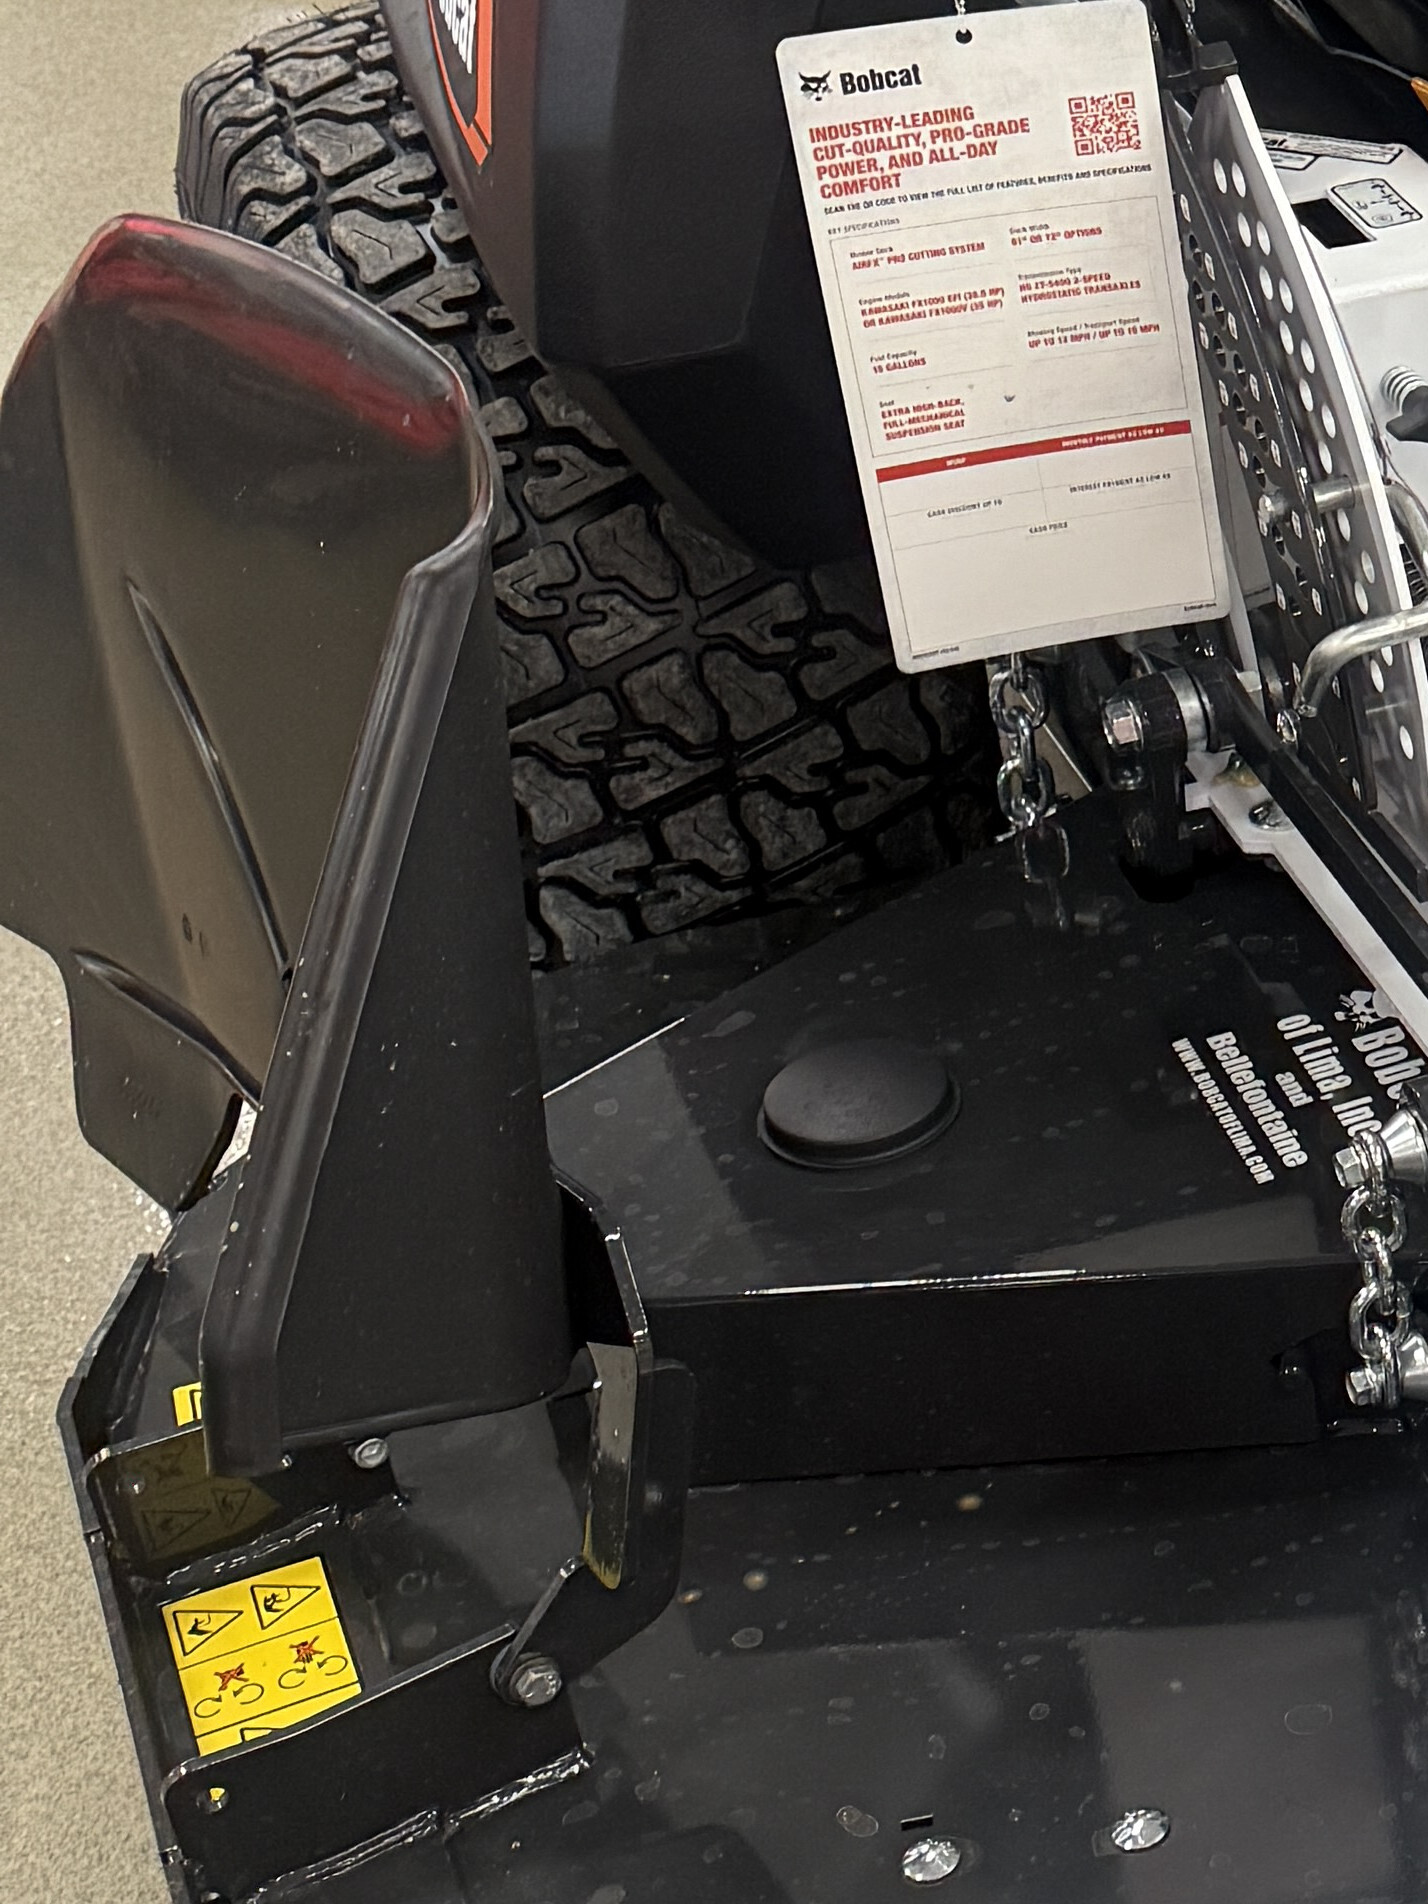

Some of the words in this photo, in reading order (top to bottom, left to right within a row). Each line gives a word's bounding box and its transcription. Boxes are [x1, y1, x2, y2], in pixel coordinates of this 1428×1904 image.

[838, 63, 922, 95] Bobcat
[807, 105, 975, 143] INDUSTRY-LEADING
[811, 131, 926, 162] CUT-QUALITY,
[928, 117, 1031, 145] PRO-GRADE
[815, 155, 884, 180] POWER,
[885, 150, 924, 169] AND
[926, 140, 999, 164] ALL-DAY
[818, 172, 903, 199] COMFORT
[823, 204, 845, 215] SCAN
[874, 196, 895, 207] CODE
[898, 195, 908, 203] TO
[909, 191, 929, 201] VIEW
[930, 189, 945, 198] THE
[946, 186, 965, 196] FULL
[966, 184, 983, 193] LIST
[984, 182, 995, 191] OF
[1075, 170, 1091, 180] AND
[907, 247, 947, 261] CUTTING
[948, 241, 985, 255] SYSTEM
[859, 299, 910, 316] KAWASAKI
[877, 309, 927, 325] KAWASAKI
[885, 357, 927, 371] GALLONS
[880, 406, 911, 419] EXTRA
[884, 423, 941, 440] SUSPENSION
[942, 419, 966, 431] SEAT
[1277, 1014, 1324, 1047] of
[1294, 1036, 1352, 1102] Lima,
[1206, 1031, 1309, 1169] Bellefontaine
[1274, 1071, 1314, 1108] and
[1171, 1037, 1275, 1186] WWW.BOBCATOFLIMA.COM
